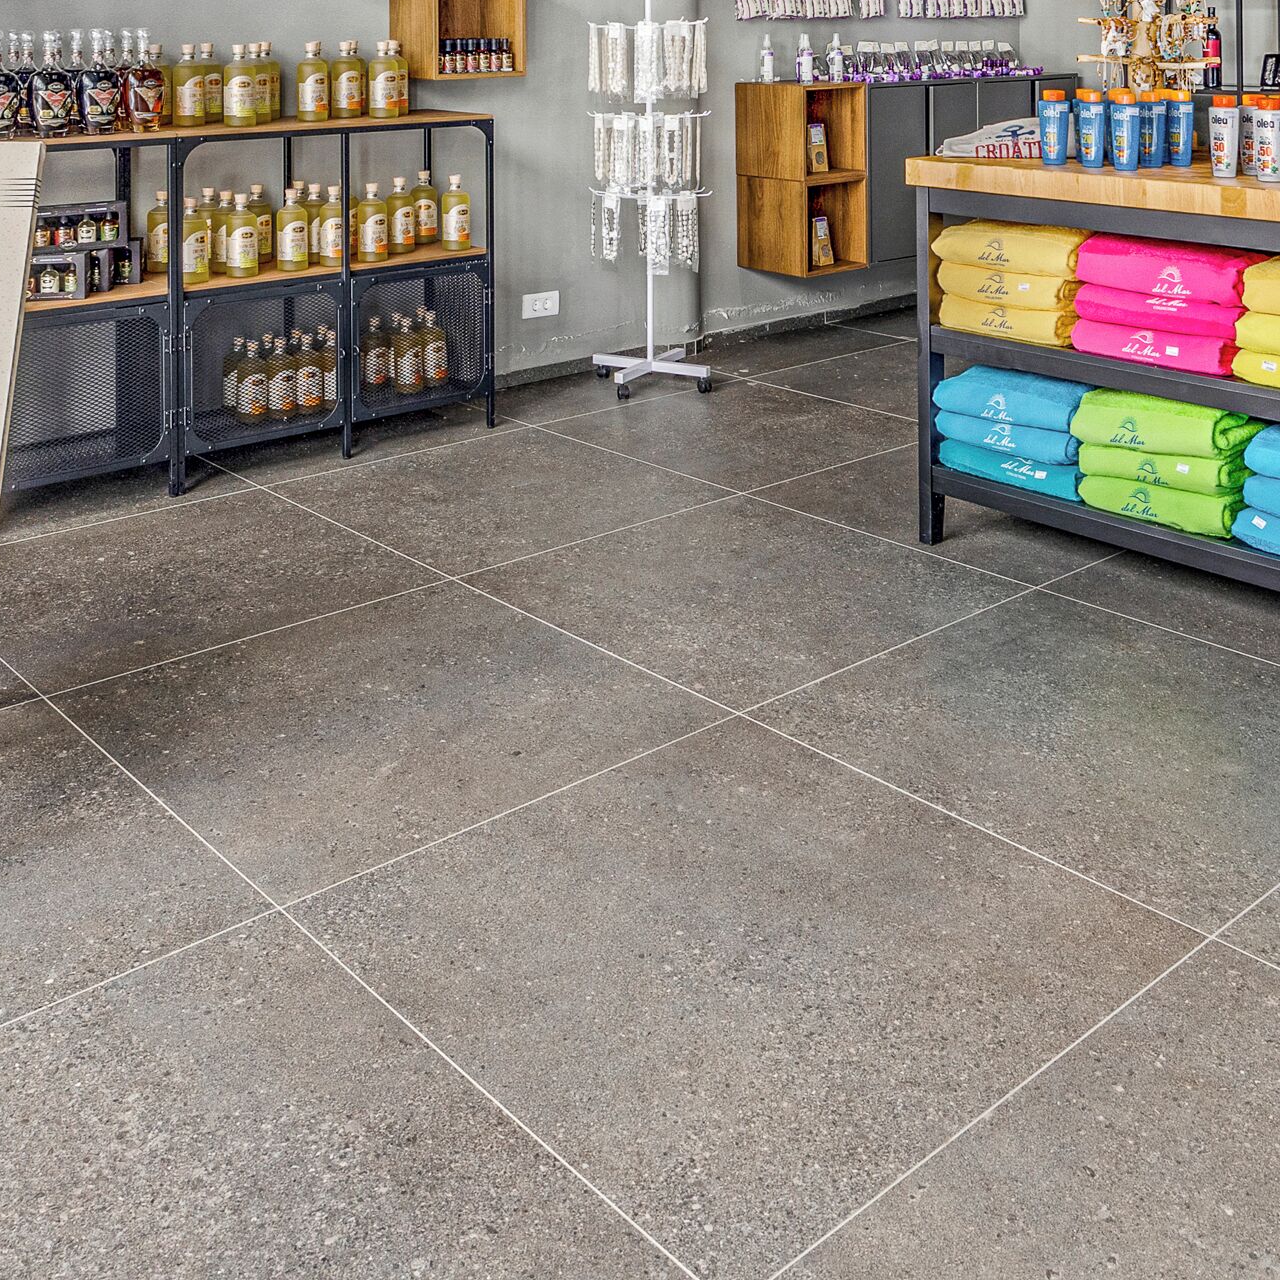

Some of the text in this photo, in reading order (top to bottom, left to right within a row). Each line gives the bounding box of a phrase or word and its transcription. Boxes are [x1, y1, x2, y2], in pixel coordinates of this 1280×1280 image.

[1211, 115, 1228, 125] olea
[1242, 114, 1254, 124] ole
[1257, 118, 1275, 128] olea
[1214, 142, 1224, 152] 50
[1260, 146, 1272, 157] 50
[977, 286, 1008, 296] del Mar
[1152, 284, 1191, 295] del Mar
[982, 318, 1013, 330] del Mar
[1122, 343, 1161, 358] del Mar
[1110, 434, 1146, 446] del Mar
[1121, 503, 1159, 518] del Mar
